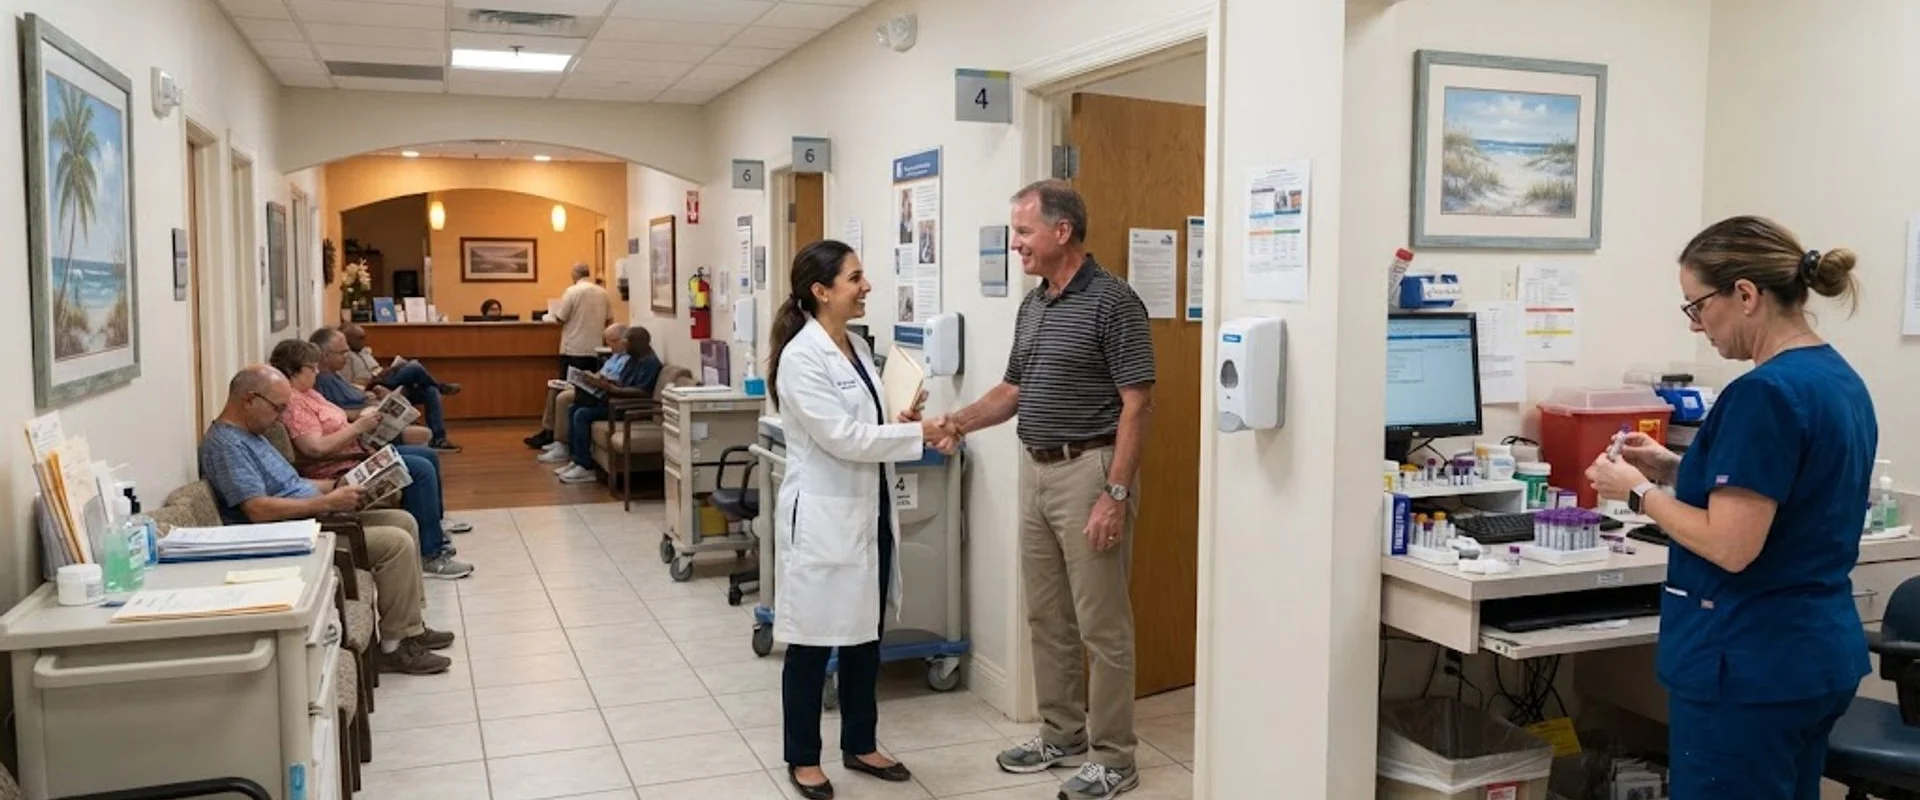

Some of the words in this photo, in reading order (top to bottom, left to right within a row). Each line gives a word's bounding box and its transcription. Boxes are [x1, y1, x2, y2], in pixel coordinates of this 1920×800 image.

[975, 88, 989, 110] 4
[805, 148, 815, 163] 6
[742, 169, 752, 182] 6
